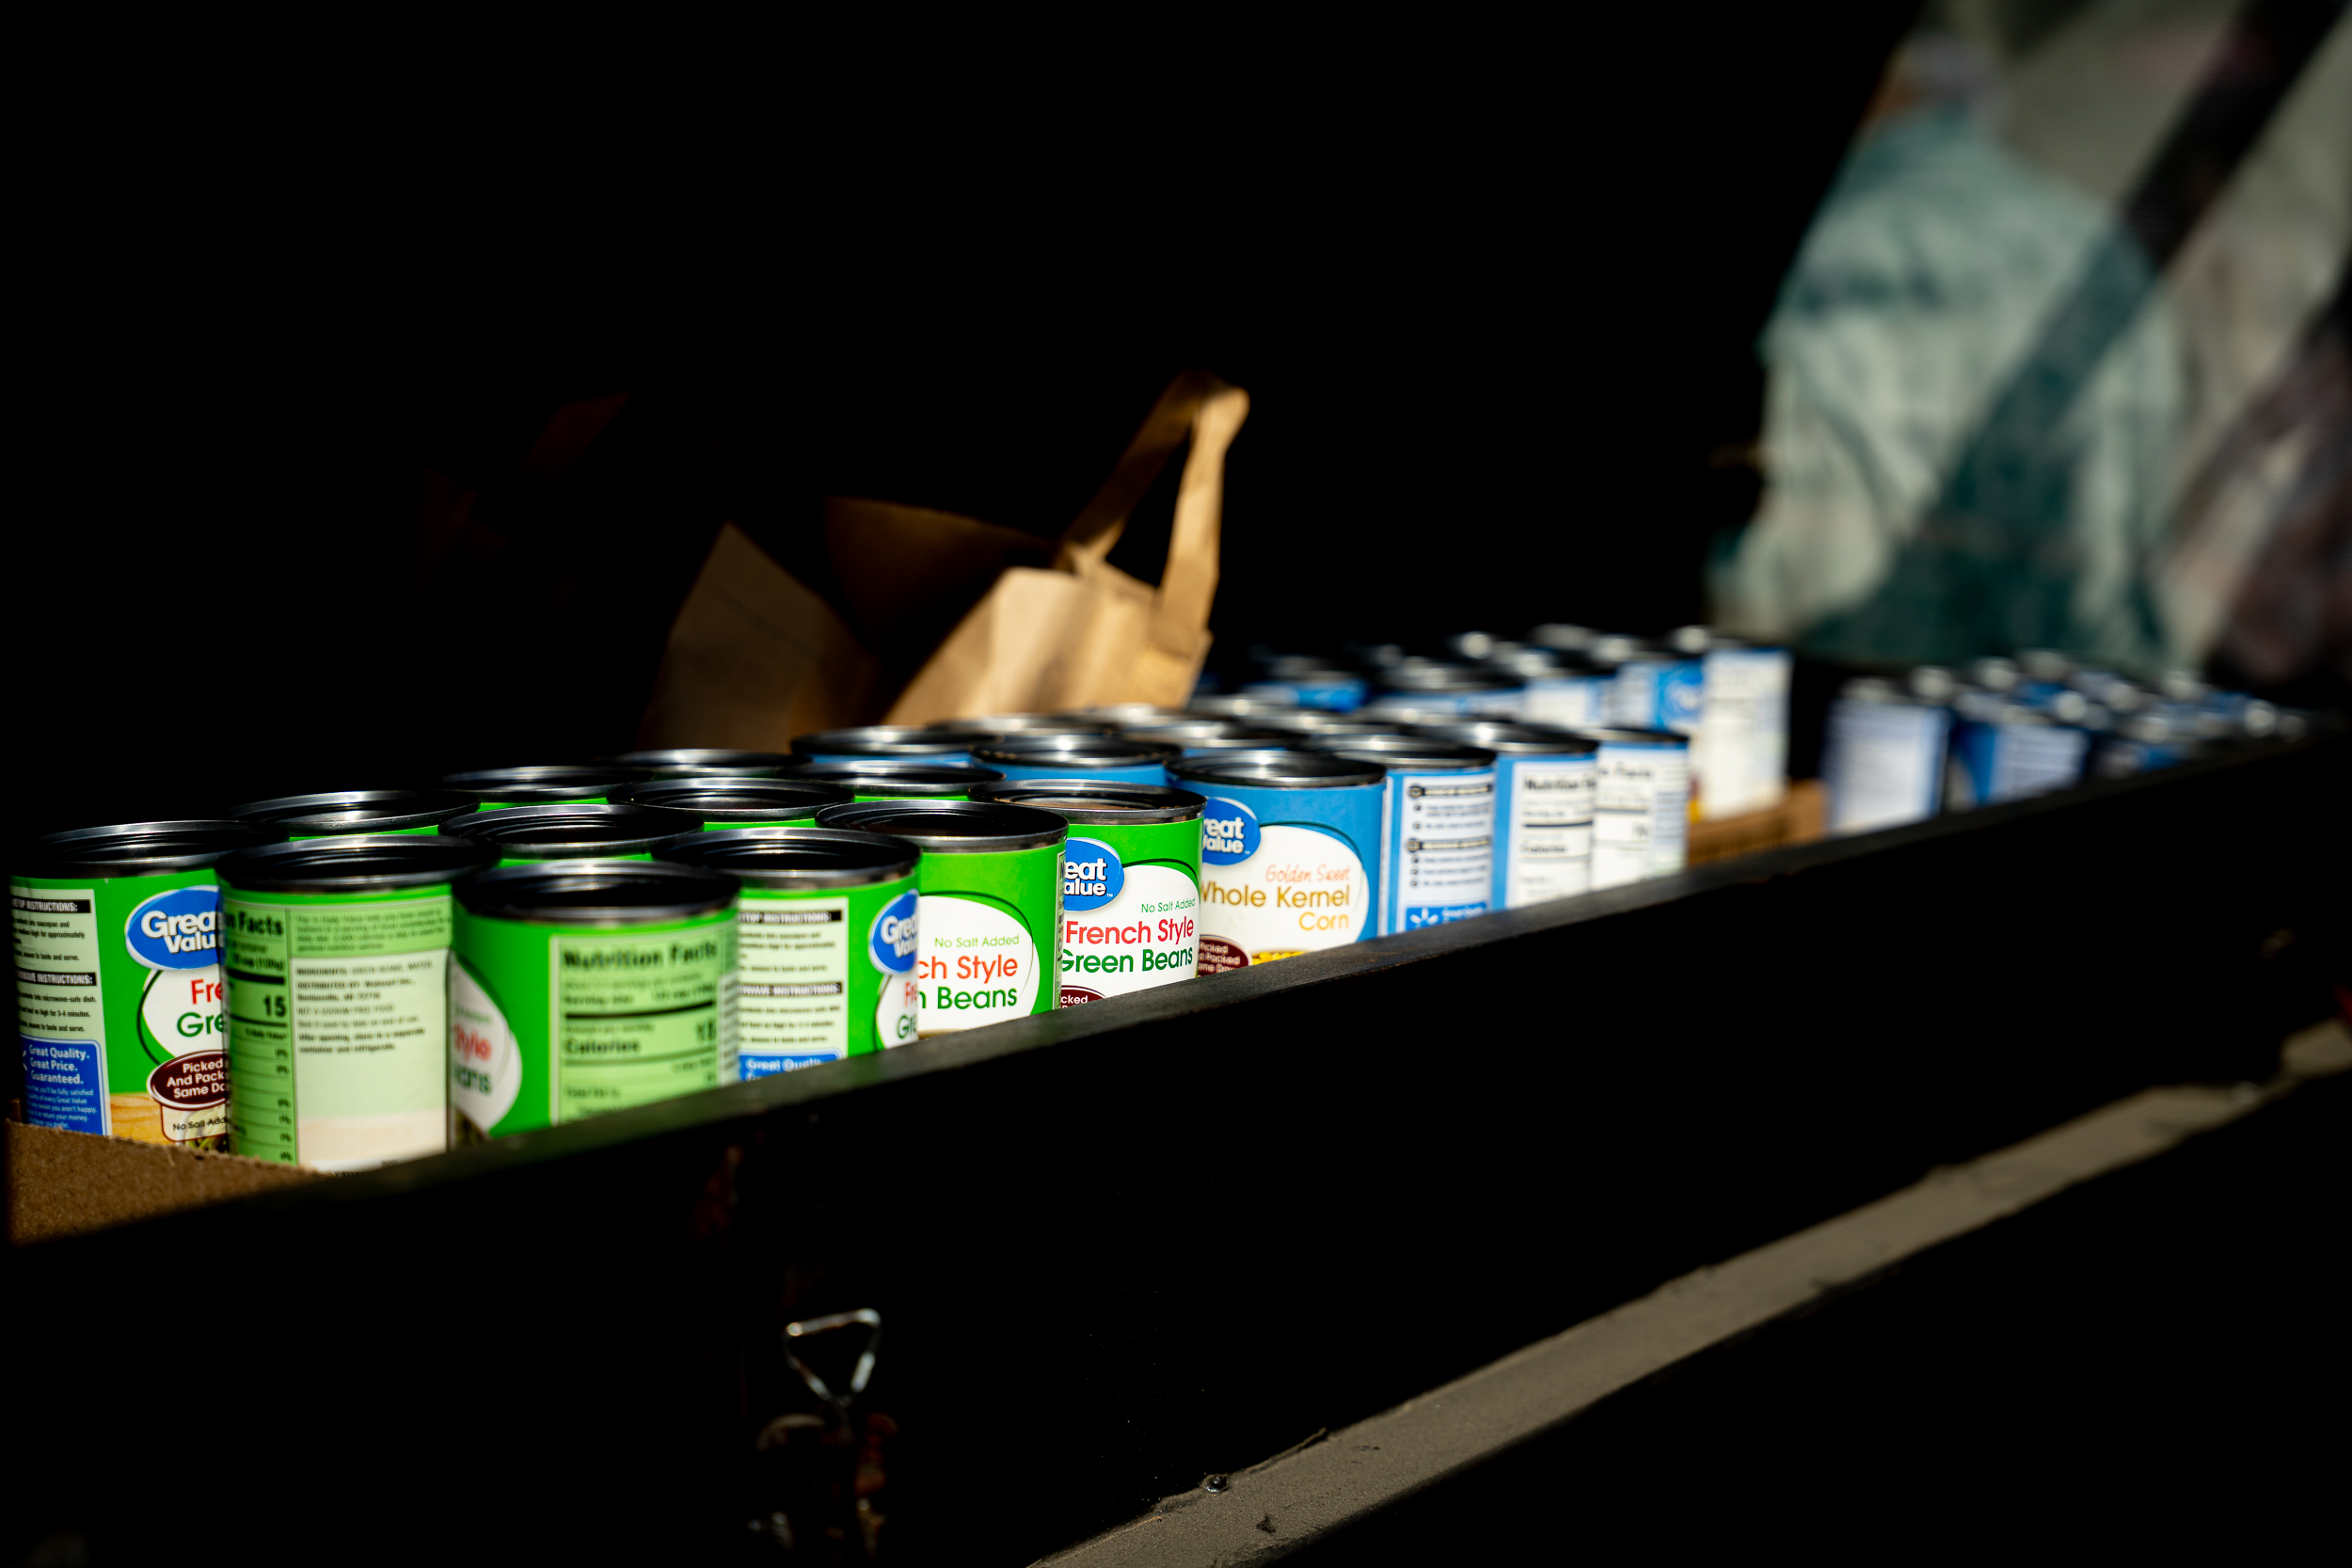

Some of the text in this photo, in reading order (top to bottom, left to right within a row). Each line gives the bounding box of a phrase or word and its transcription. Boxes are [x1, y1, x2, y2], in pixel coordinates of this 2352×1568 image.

[1203, 816, 1245, 840] reat
[1064, 858, 1108, 881] eat
[1265, 863, 1351, 883] Golden Sweet
[1063, 879, 1107, 896] alue
[1277, 884, 1350, 909] Kernel
[27, 900, 78, 911] INSTRUCTIONS:
[1141, 898, 1196, 913] No Salt Added
[238, 911, 285, 936] Facts
[881, 915, 918, 945] Grea
[1066, 915, 1194, 945] French Style
[1298, 911, 1350, 931] Corn
[163, 930, 217, 954] Valu
[893, 938, 918, 958] Valu
[934, 934, 1020, 948] No Salt Added
[565, 948, 663, 970] Nutrition
[1141, 946, 1194, 973] Beans
[38, 974, 93, 985] INSTRUCTIONS:
[957, 954, 1019, 985] Style
[191, 978, 223, 1005] Fre
[937, 986, 1018, 1010] Beans
[1060, 994, 1089, 1006] cked
[262, 993, 288, 1018] 15
[177, 1011, 224, 1037] Gre
[29, 1044, 90, 1062] Great Quality.
[565, 1037, 640, 1054] Calories
[30, 1057, 78, 1072] Great Price.
[183, 1058, 225, 1074] Picked
[31, 1069, 84, 1085] Guaranteed.
[167, 1070, 225, 1088] And Pack
[173, 1083, 226, 1100] Same Da
[173, 1122, 187, 1132] No
[188, 1119, 205, 1130] Salt
